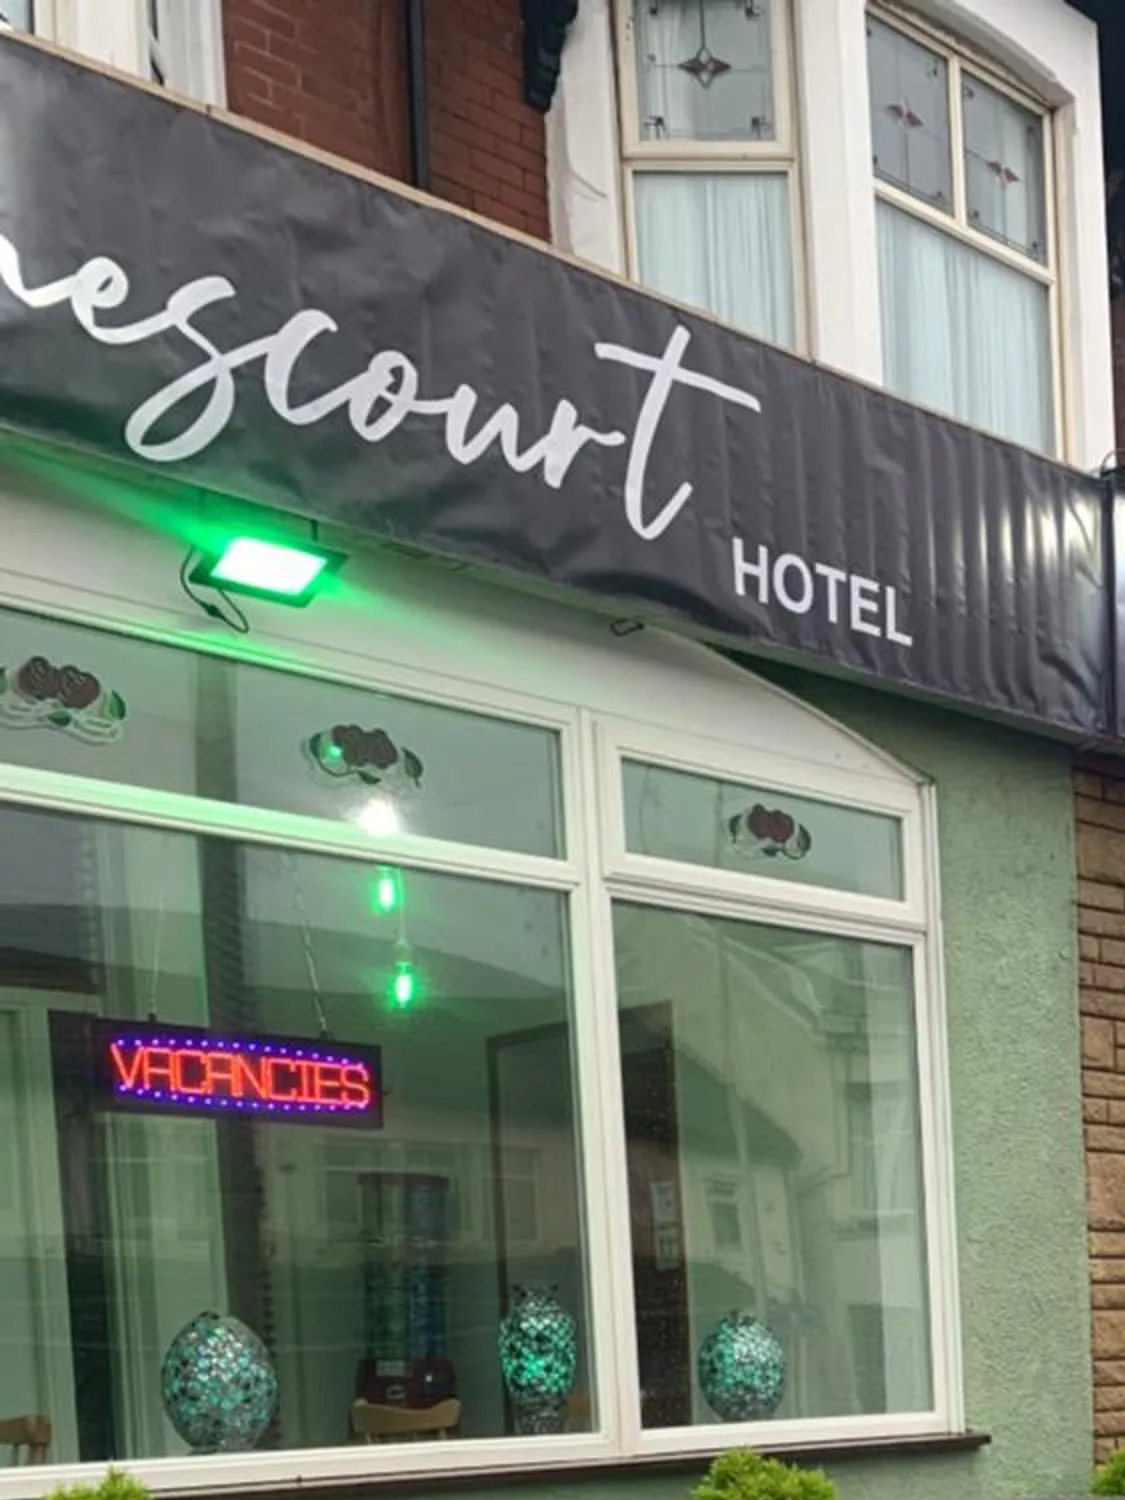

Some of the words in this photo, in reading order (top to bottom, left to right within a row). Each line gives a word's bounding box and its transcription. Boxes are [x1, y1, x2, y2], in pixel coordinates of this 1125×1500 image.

[0, 233, 762, 540] escourt
[731, 536, 914, 647] HOTEL
[110, 1042, 370, 1107] VACANCIES
